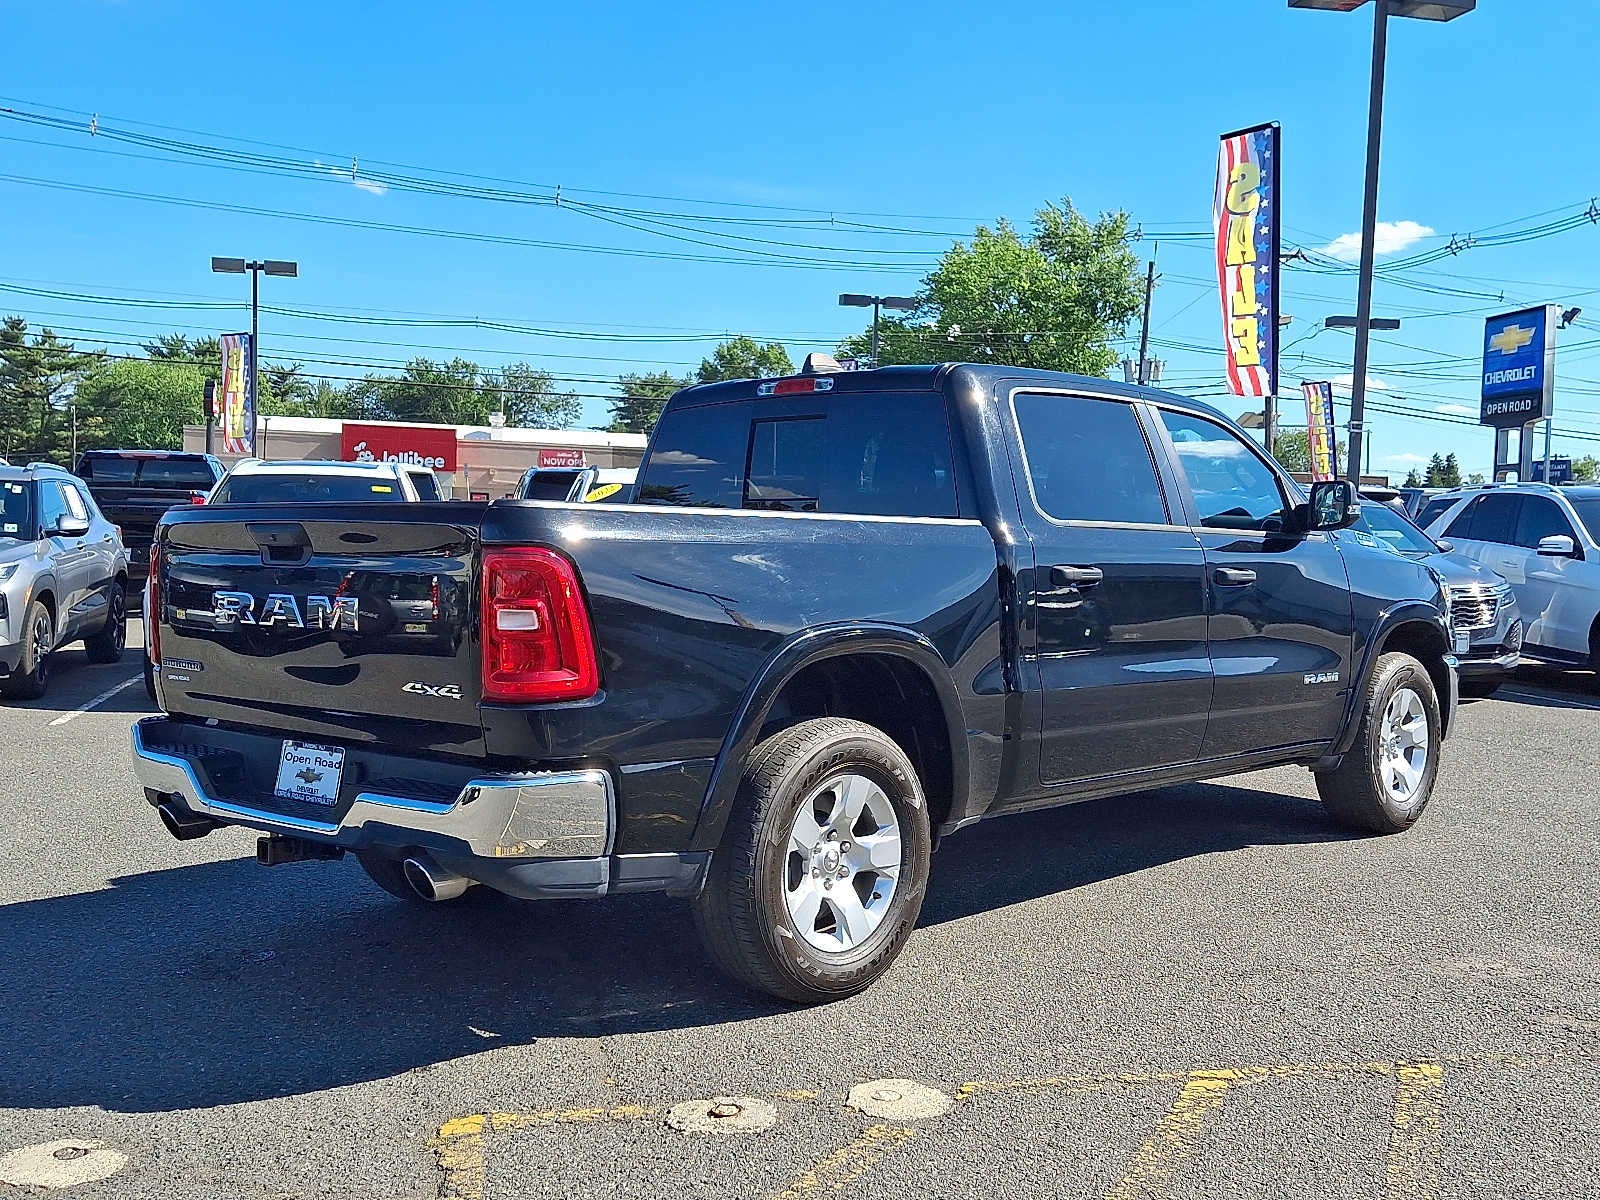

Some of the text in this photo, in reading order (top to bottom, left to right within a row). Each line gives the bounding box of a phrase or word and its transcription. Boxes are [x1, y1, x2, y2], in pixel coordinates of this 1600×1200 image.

[1484, 366, 1537, 385] CHEVROLET
[1487, 400, 1532, 415] OPEN ROAD
[377, 451, 446, 468] Jollibee
[543, 457, 566, 467] NOW
[212, 591, 359, 632] RAM
[1303, 671, 1340, 685] RAM
[285, 751, 342, 770] Open Road
